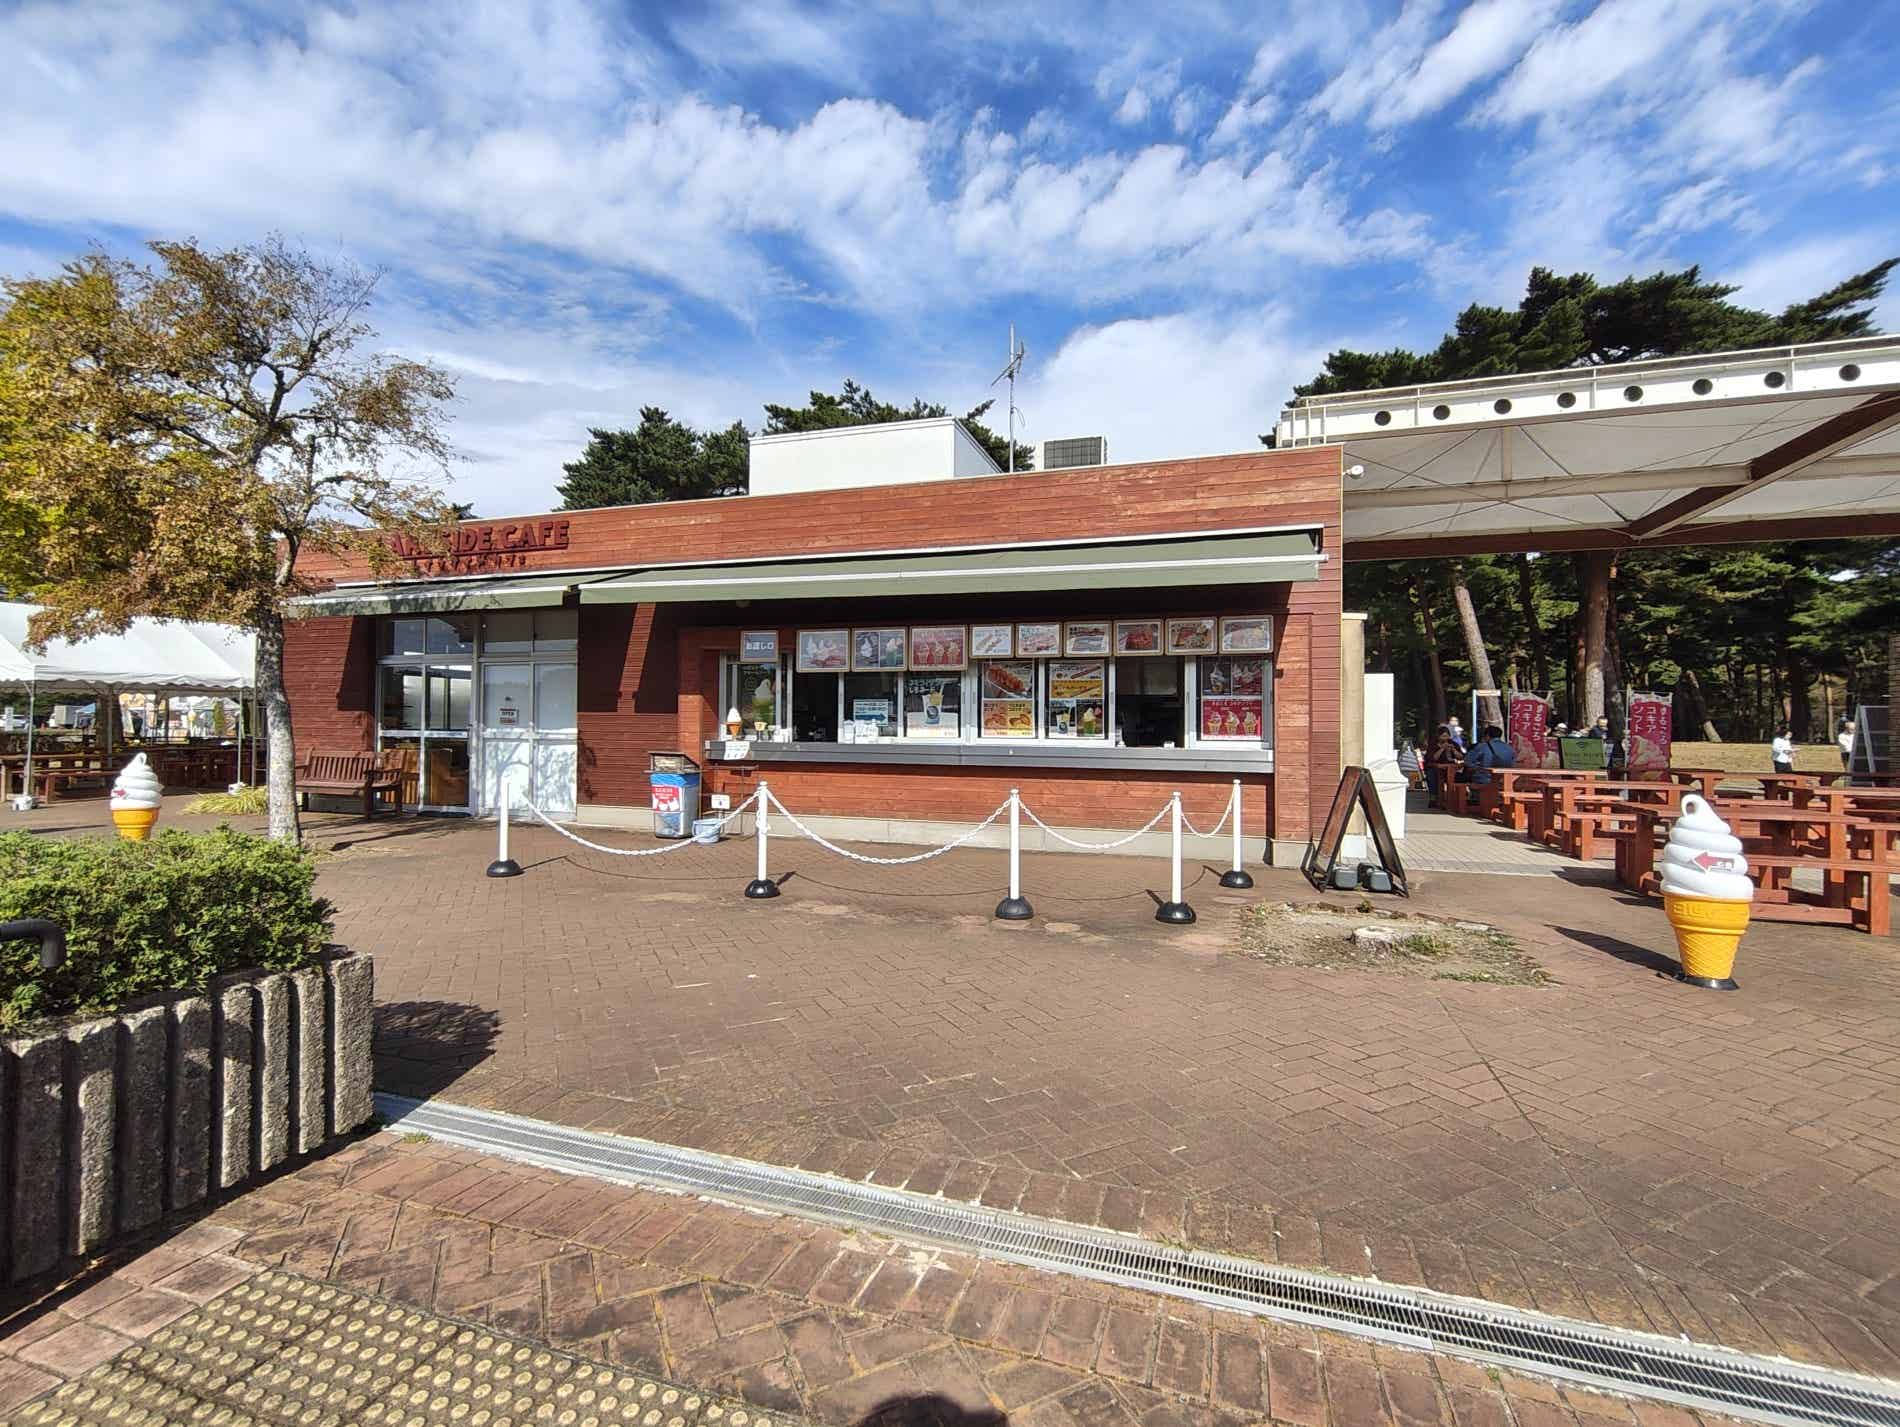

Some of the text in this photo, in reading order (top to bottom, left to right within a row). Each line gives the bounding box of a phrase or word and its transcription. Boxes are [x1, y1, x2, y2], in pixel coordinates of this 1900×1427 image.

[500, 520, 570, 549] CAFE
[1521, 703, 1533, 730] コキア
[1633, 705, 1644, 733] ソフト
[1647, 705, 1657, 733] コキア
